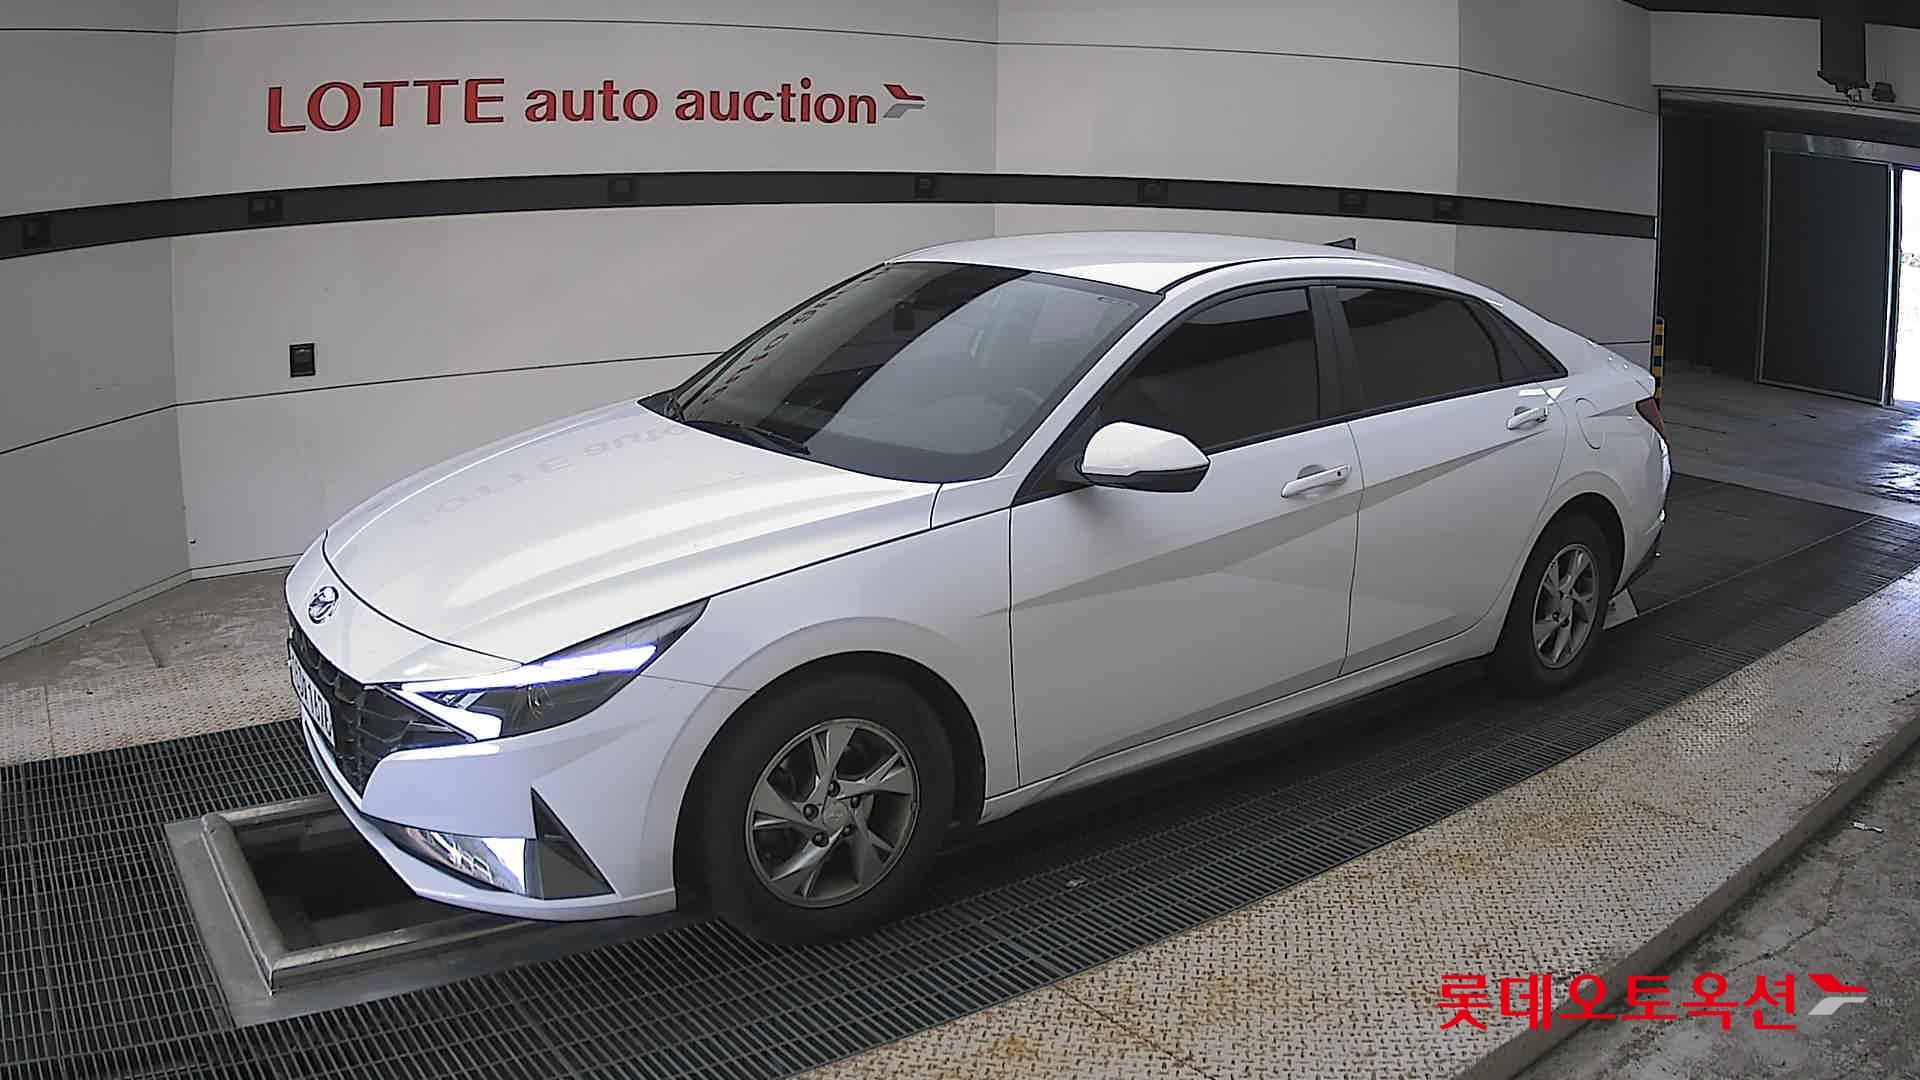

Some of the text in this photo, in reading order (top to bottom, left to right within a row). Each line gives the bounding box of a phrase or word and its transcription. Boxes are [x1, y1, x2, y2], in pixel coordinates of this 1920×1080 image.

[266, 77, 878, 133] LOTTE auto auction
